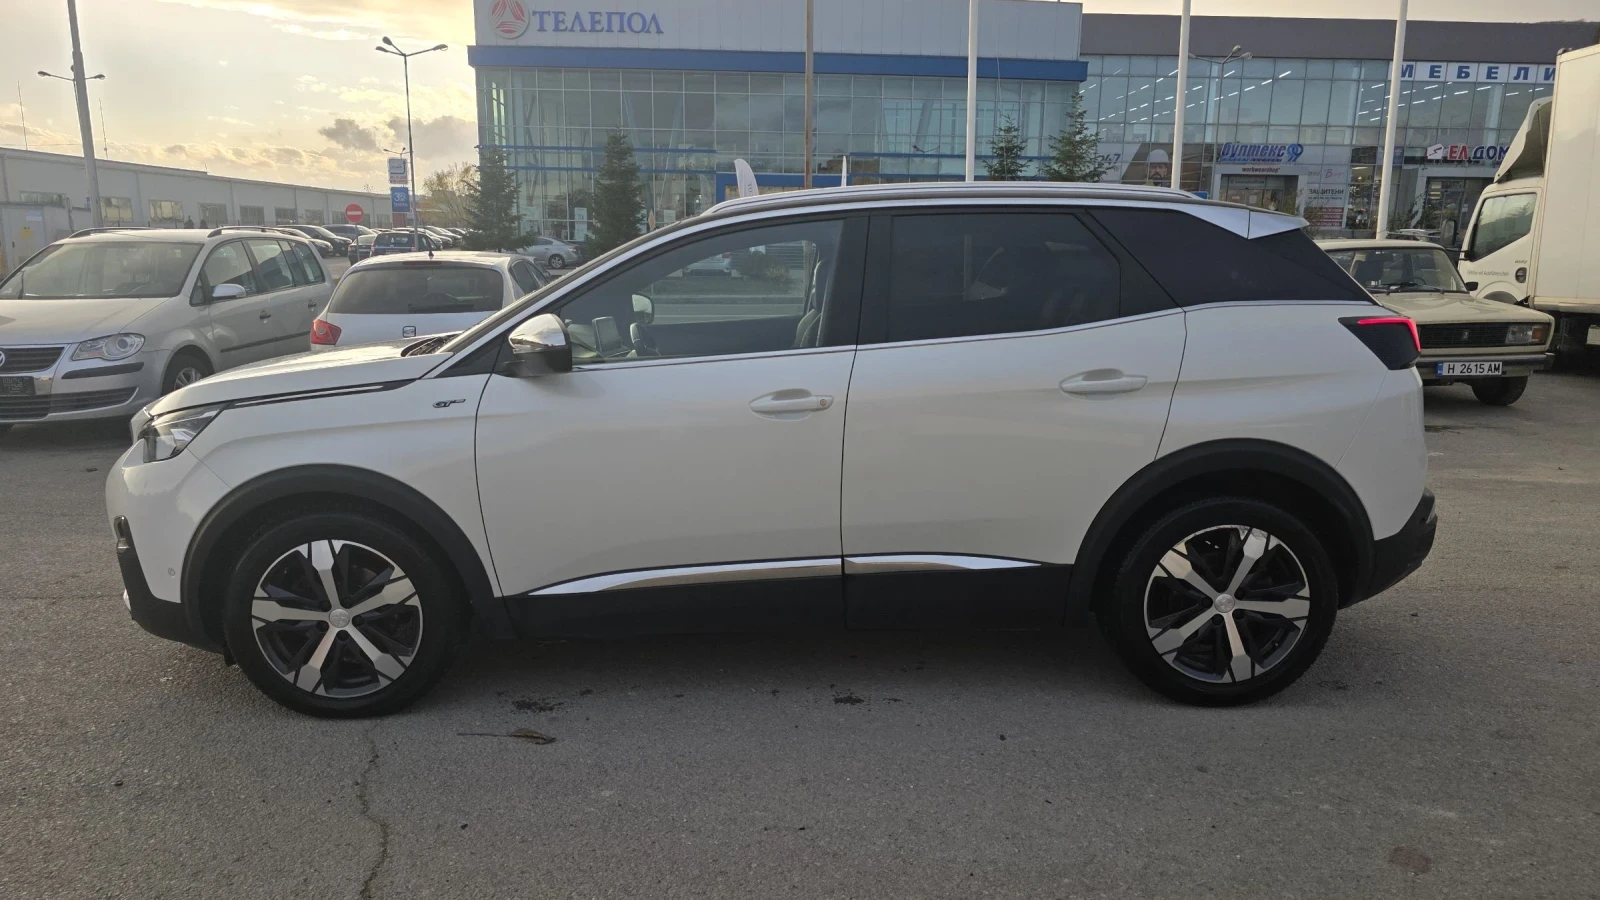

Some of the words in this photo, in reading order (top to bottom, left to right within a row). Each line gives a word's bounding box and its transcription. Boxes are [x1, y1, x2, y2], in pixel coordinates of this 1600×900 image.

[532, 10, 664, 34] ТЕЛЕПОЛ
[1448, 145, 1469, 160] ЕЛ
[1447, 363, 1455, 374] H
[1460, 363, 1485, 374] 2615
[1487, 363, 1501, 374] AM
